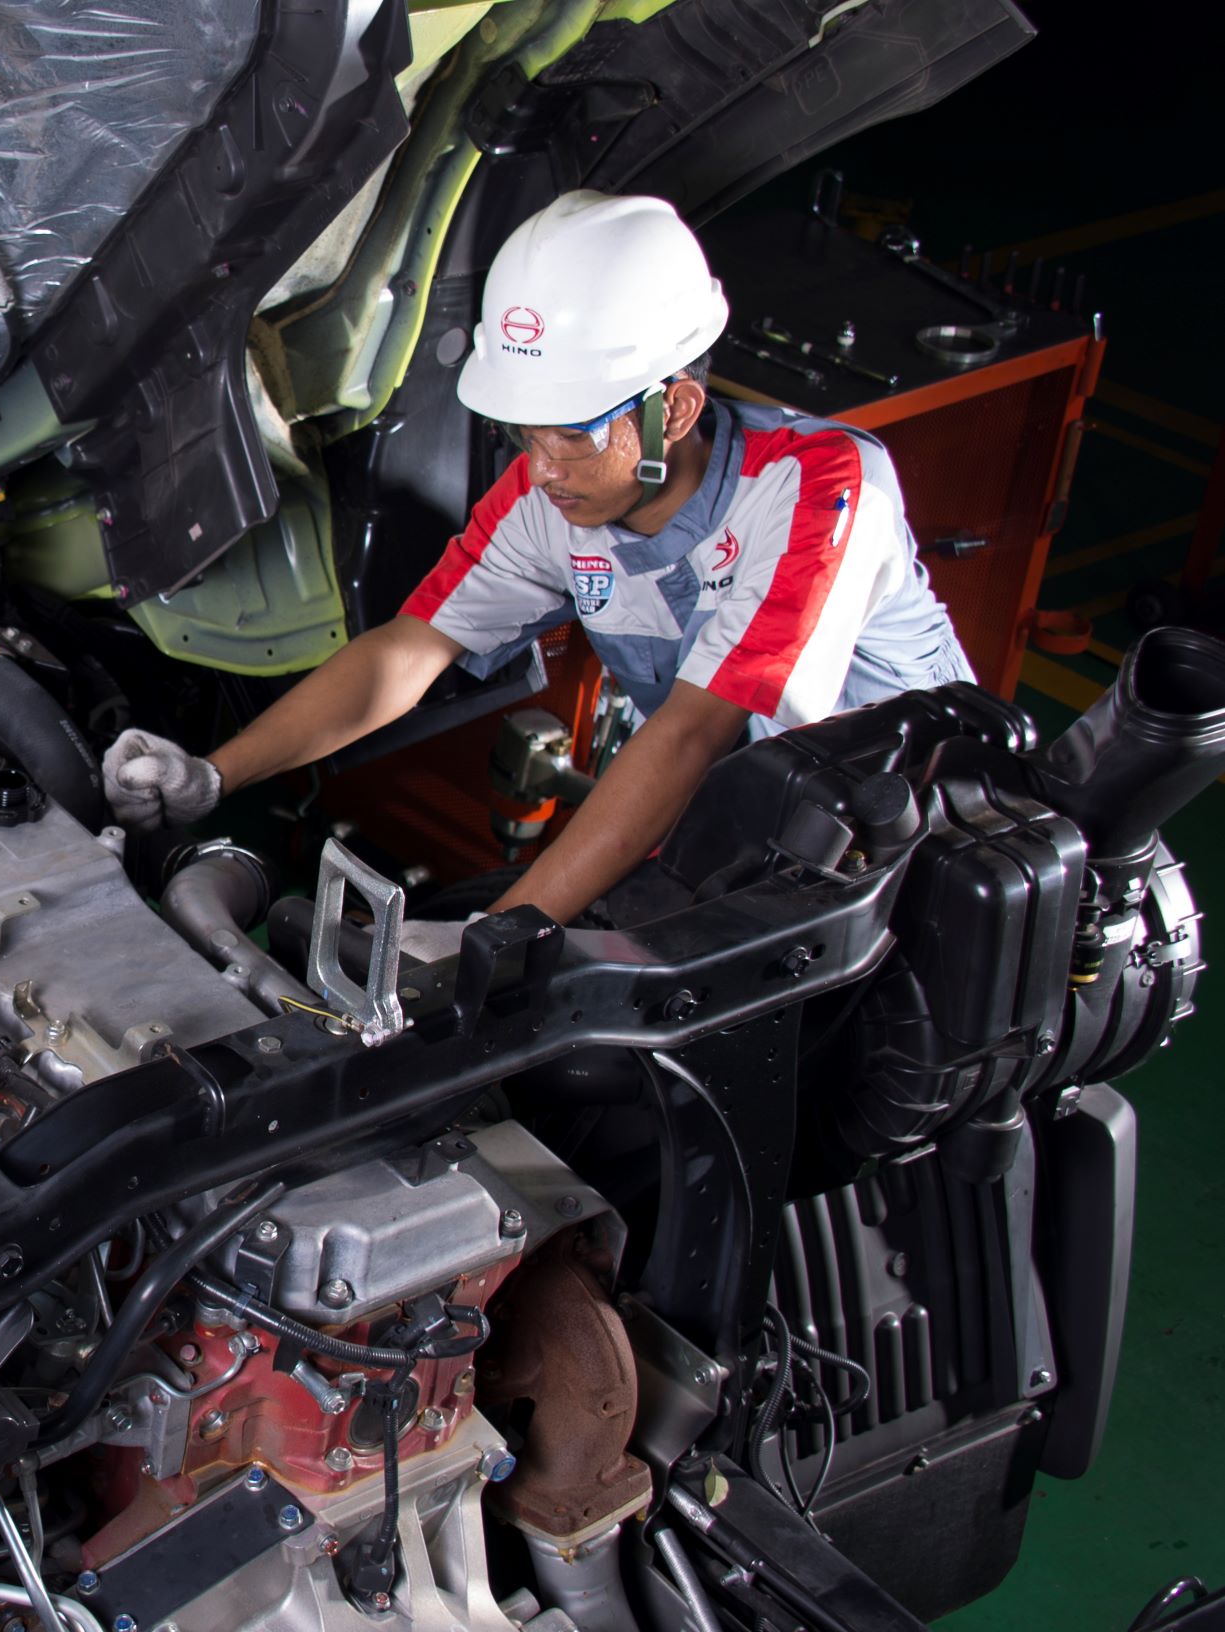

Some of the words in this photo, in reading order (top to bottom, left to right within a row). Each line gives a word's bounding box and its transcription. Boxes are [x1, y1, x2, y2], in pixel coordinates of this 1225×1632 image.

[501, 343, 542, 357] HINO
[571, 559, 611, 569] HINO
[575, 575, 610, 596] SP
[702, 575, 733, 591] INO
